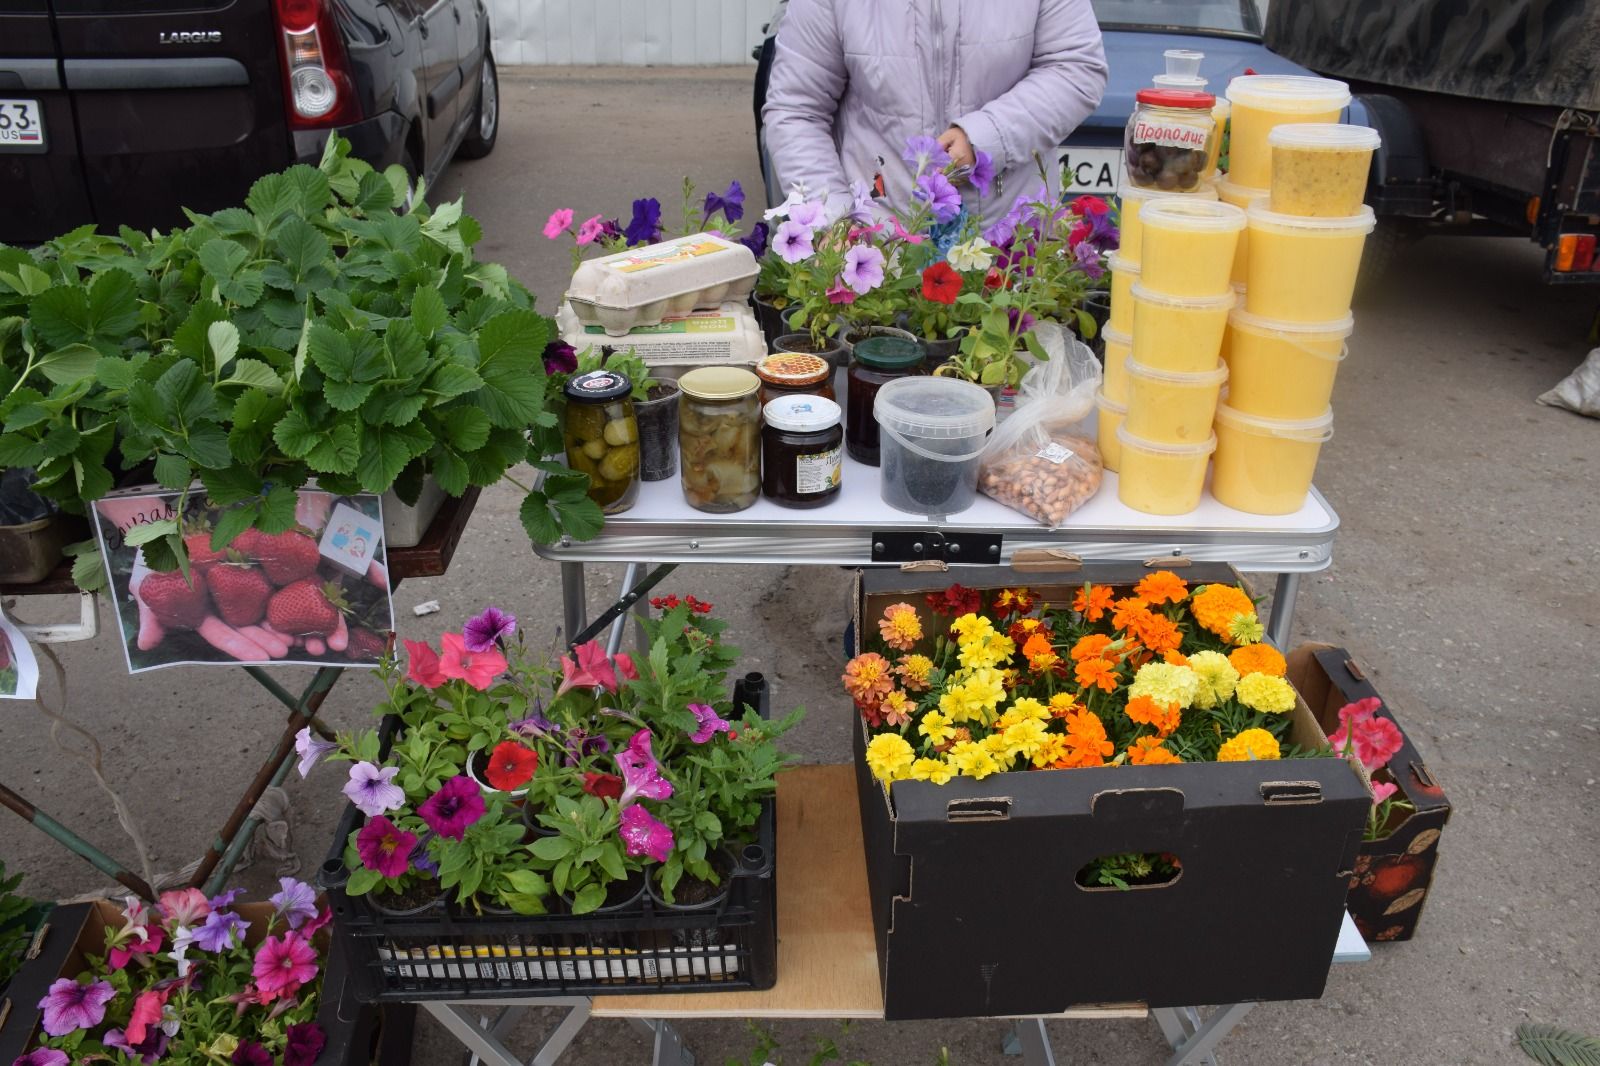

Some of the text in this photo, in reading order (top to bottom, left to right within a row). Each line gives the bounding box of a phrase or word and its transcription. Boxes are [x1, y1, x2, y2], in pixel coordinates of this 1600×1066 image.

[160, 31, 222, 44] LARGUS
[0, 130, 18, 140] US
[1135, 123, 1205, 145] Прополис
